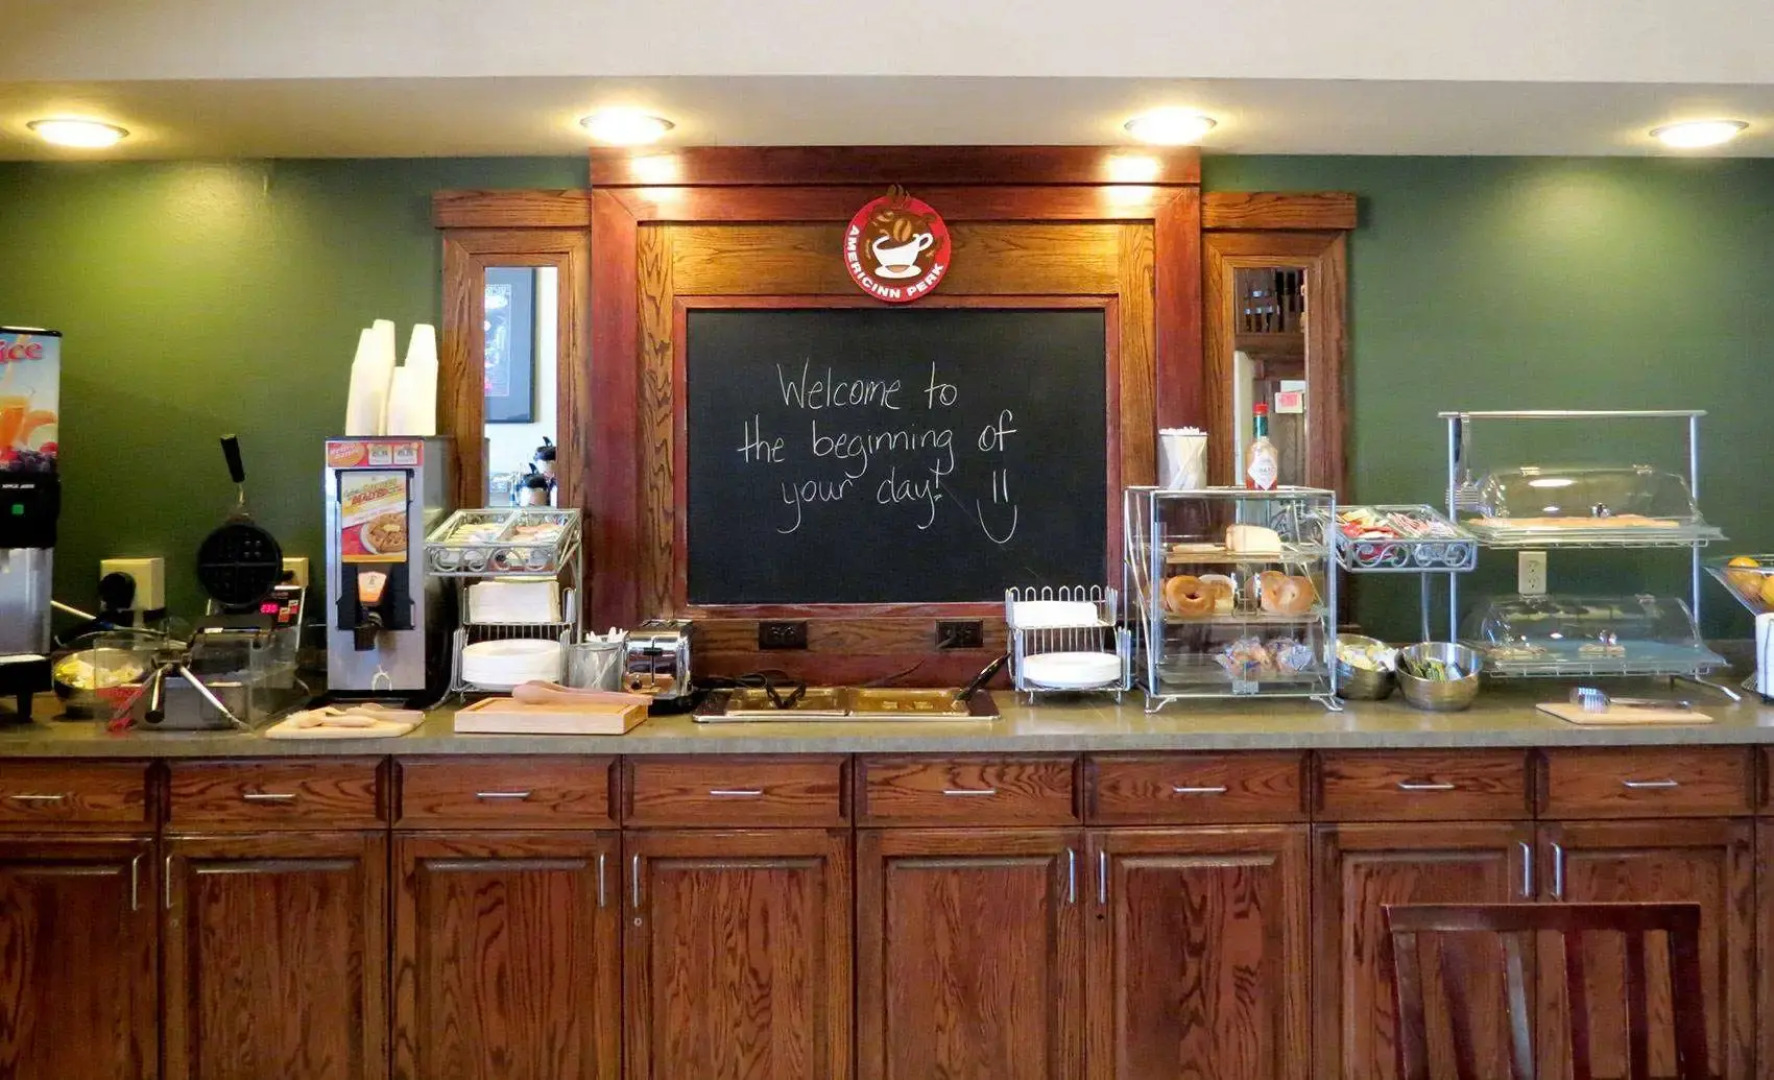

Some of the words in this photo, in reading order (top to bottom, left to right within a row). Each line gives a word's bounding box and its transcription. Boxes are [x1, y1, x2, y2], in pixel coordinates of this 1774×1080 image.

[846, 225, 900, 298] AMERICINN
[906, 263, 944, 296] PERK
[777, 357, 901, 410] Welcome
[924, 361, 958, 409] to
[737, 414, 785, 463] the
[812, 420, 954, 478] beginning
[978, 409, 1017, 452] of
[776, 479, 852, 534] your
[876, 458, 943, 530] day!
